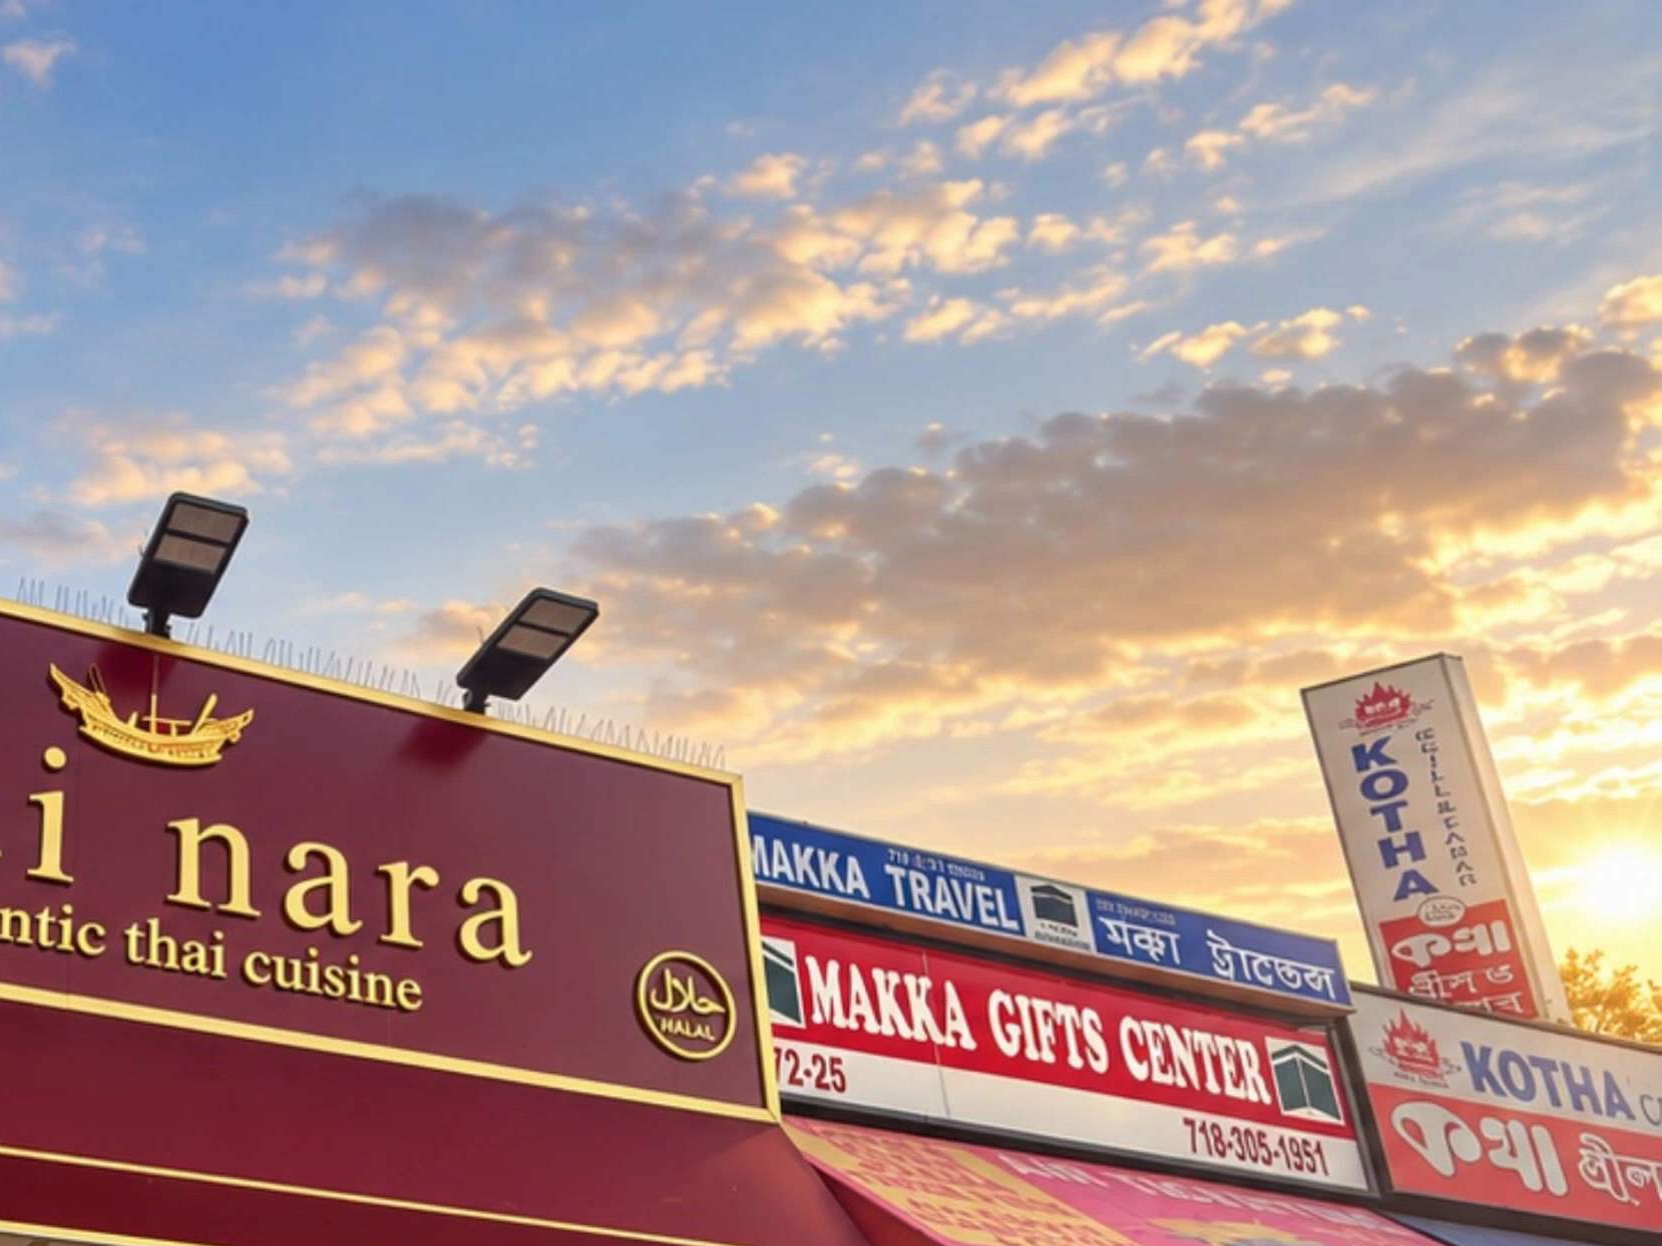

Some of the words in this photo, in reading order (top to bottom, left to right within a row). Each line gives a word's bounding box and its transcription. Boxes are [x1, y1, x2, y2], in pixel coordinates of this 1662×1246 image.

[1351, 736, 1439, 902] KOTHA
[166, 817, 533, 968] nara
[752, 834, 871, 899] MAKKA
[885, 863, 1020, 931] TRAVEL
[124, 917, 228, 978] thai
[243, 947, 424, 1012] cuisine
[650, 967, 726, 1014] حلال
[773, 1046, 846, 1094] 72-25
[804, 955, 977, 1051] MAKKA
[988, 989, 1109, 1074] GIFTS
[1121, 1014, 1271, 1105] CENTER
[1460, 1041, 1636, 1121] KOTHA
[1182, 1116, 1329, 1178] 718-305-1951
